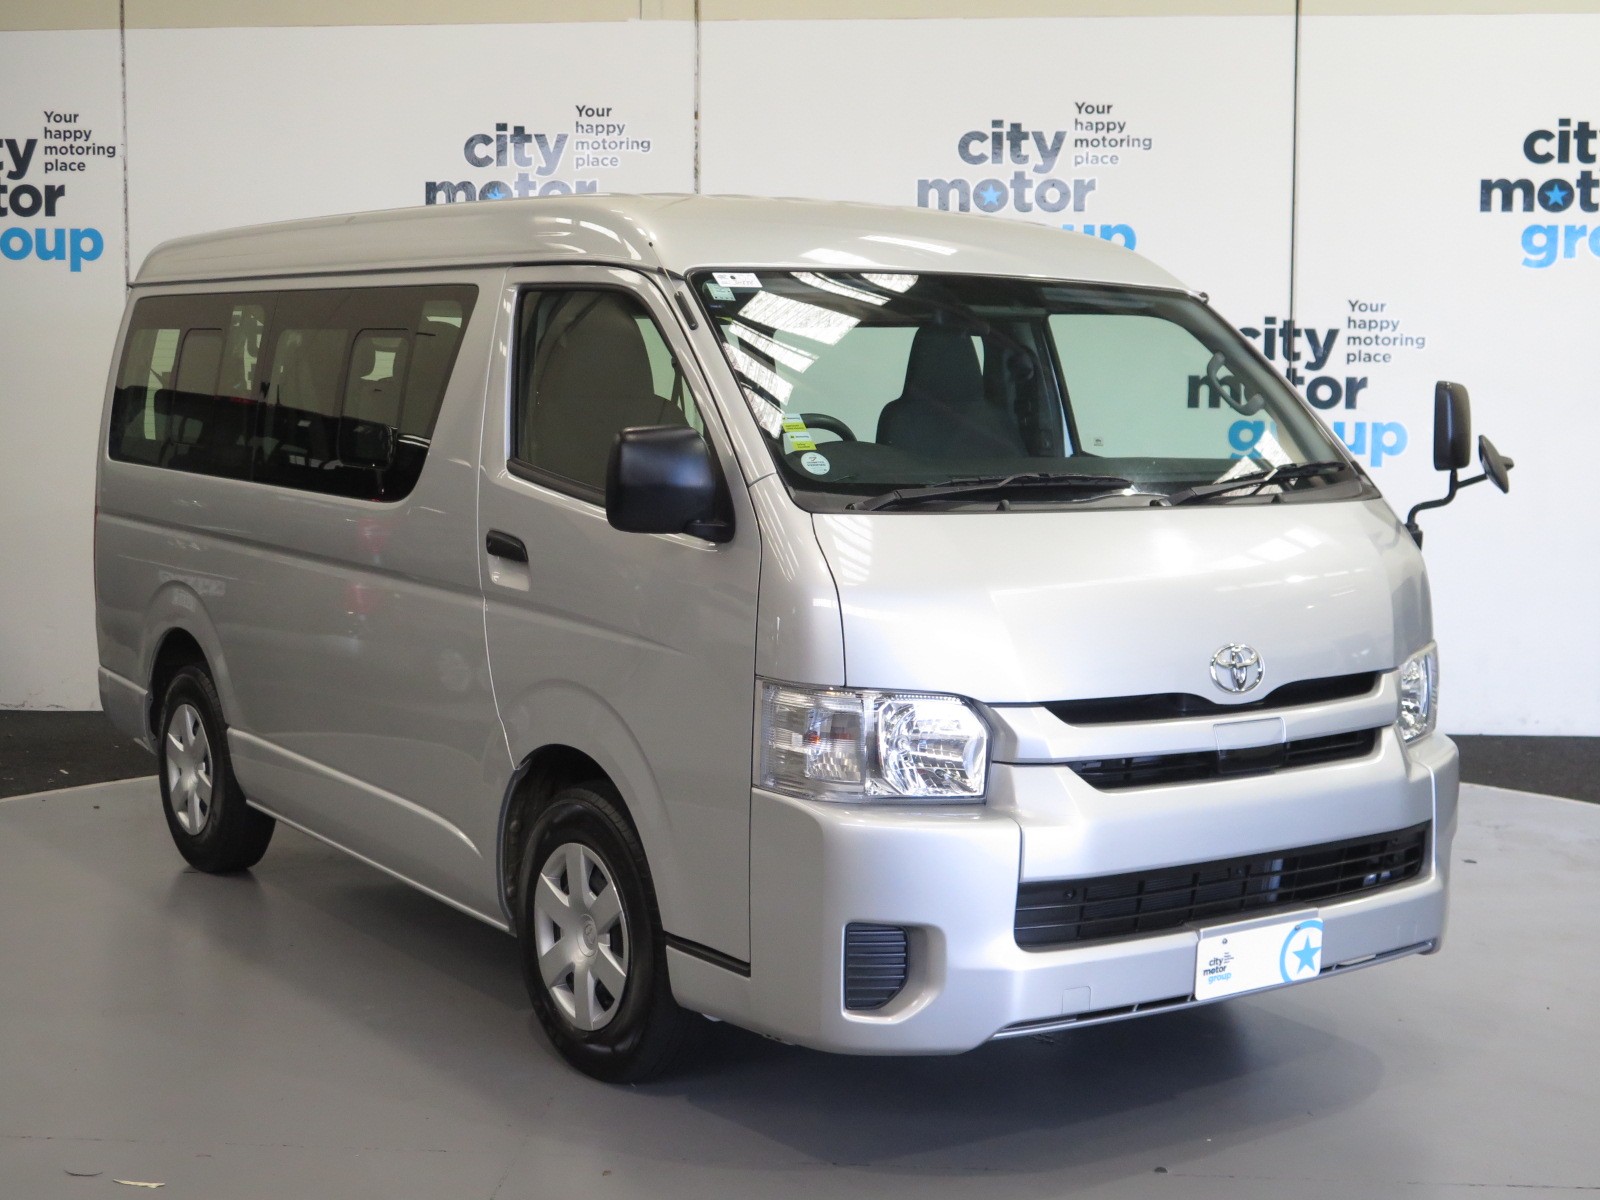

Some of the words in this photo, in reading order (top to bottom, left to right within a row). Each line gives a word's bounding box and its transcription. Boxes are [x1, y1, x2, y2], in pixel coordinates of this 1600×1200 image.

[576, 105, 612, 118] Your
[1075, 102, 1113, 114] Your
[44, 111, 79, 123] Your
[575, 121, 625, 136] happy
[1074, 118, 1126, 133] happy
[44, 127, 92, 141] happy
[1523, 118, 1600, 164] cit
[463, 123, 569, 176] city
[575, 138, 651, 152] motoring
[958, 120, 1067, 174] city
[1074, 135, 1153, 150] motoring
[44, 143, 116, 157] motoring
[0, 139, 38, 180] y
[44, 159, 86, 173] place
[575, 155, 619, 169] place
[1074, 152, 1119, 166] place
[917, 171, 1096, 213] motor
[0, 227, 104, 272] oup
[1348, 300, 1387, 312] Your
[1347, 316, 1400, 331] happy
[1346, 334, 1426, 349] motoring
[1346, 351, 1392, 364] place
[1187, 367, 1368, 410] mor
[1228, 420, 1408, 467] gup
[1209, 957, 1223, 966] city
[1203, 966, 1226, 976] motor
[1208, 973, 1231, 984] group
